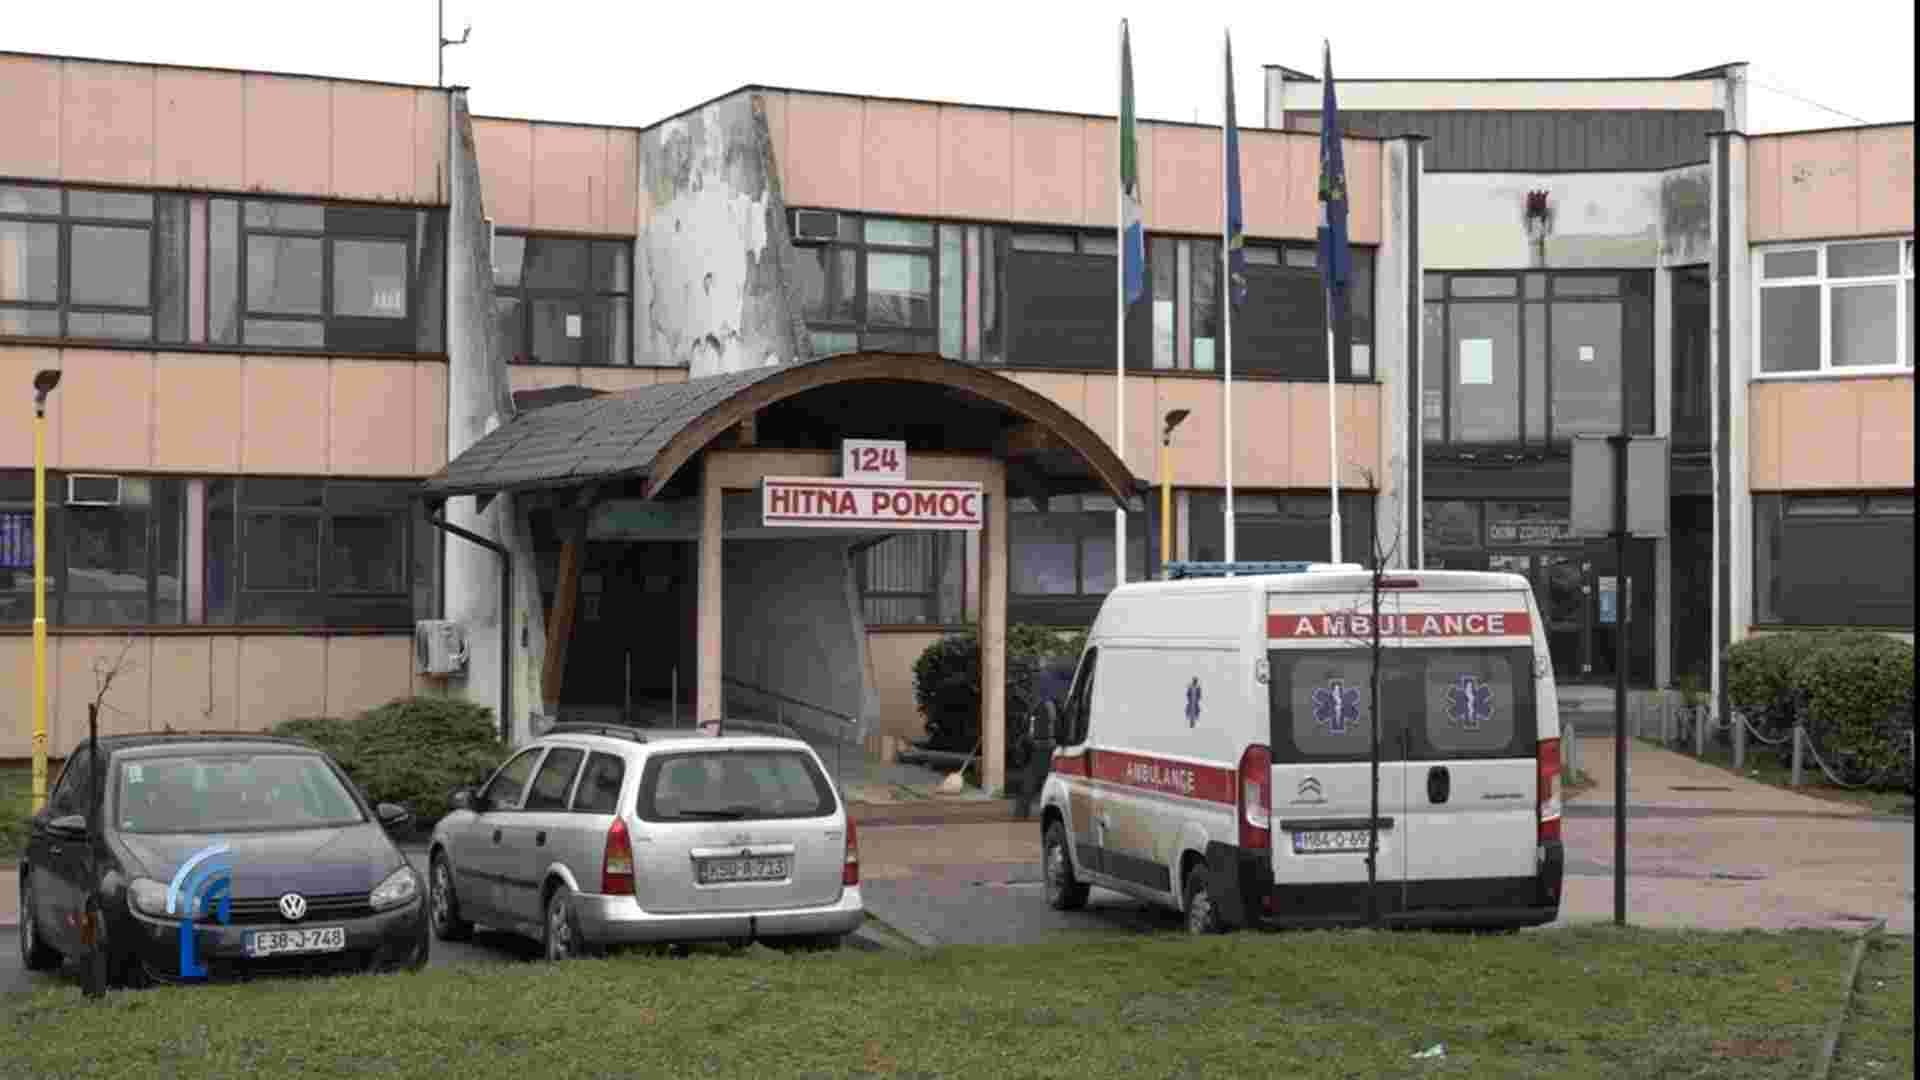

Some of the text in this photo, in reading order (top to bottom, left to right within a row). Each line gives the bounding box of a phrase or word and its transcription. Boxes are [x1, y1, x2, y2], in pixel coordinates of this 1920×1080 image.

[850, 447, 899, 472] 124
[769, 488, 977, 517] HITNA POMOC
[1293, 613, 1505, 635] AMBULANCE
[1124, 761, 1196, 794] AMBULANCE
[257, 930, 342, 951] E38-J-748
